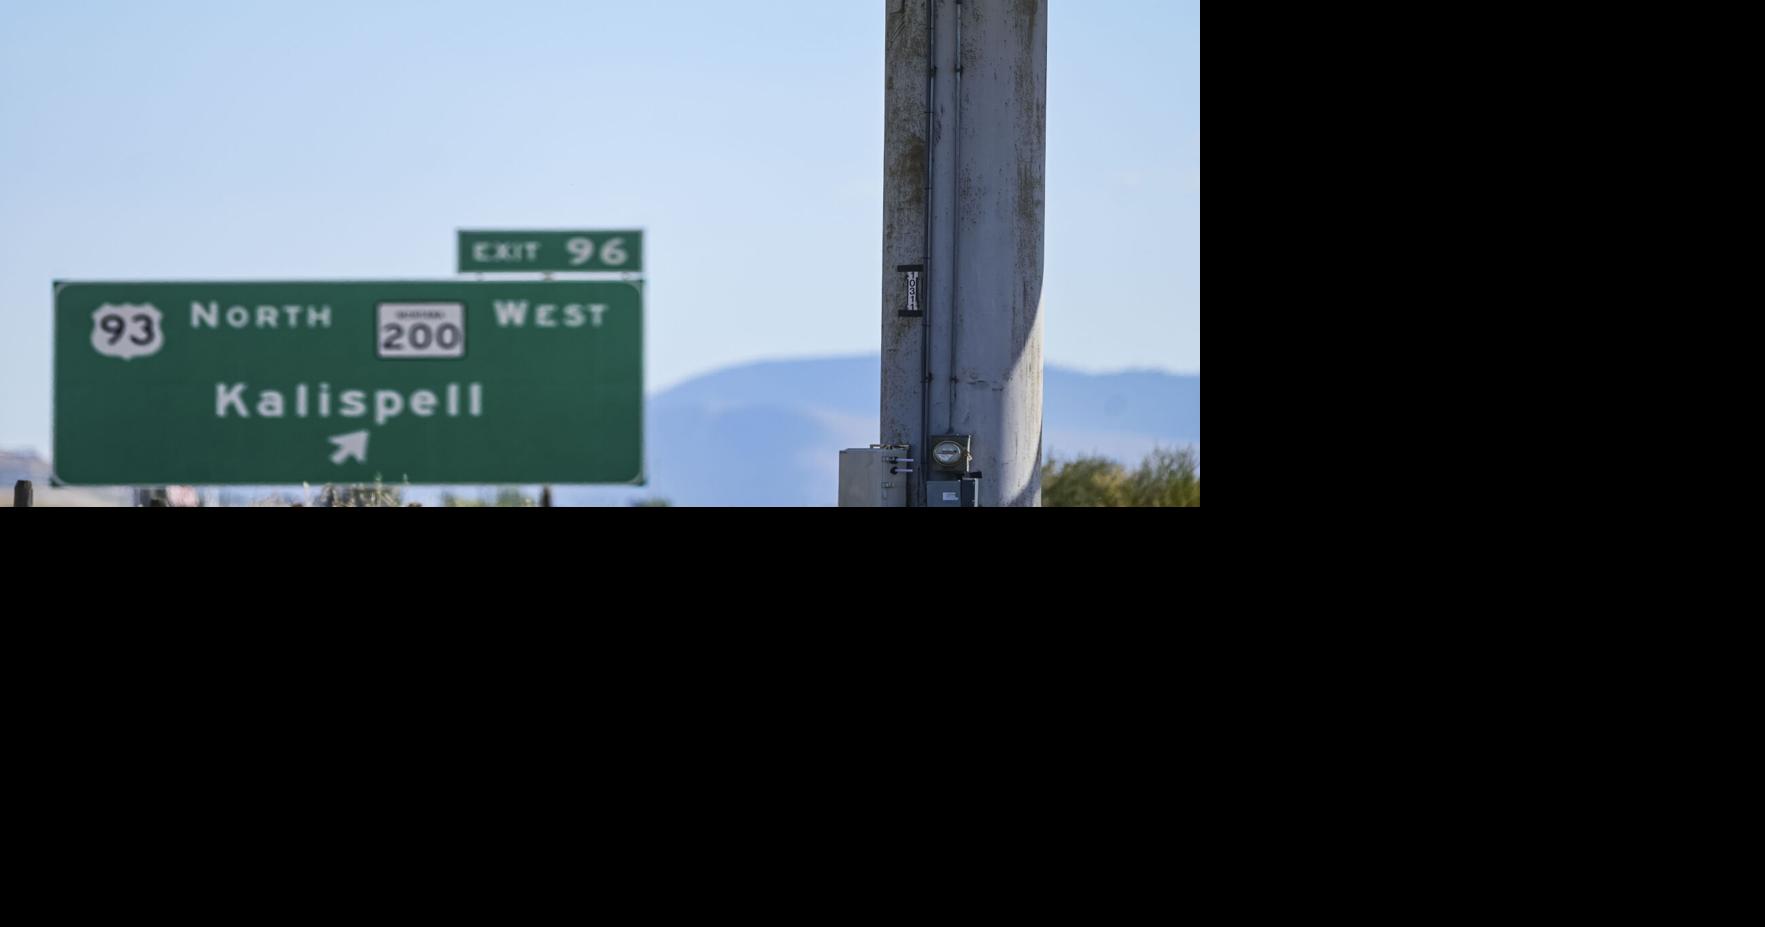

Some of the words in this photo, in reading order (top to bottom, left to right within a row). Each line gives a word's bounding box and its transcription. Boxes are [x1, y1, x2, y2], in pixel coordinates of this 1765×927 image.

[472, 241, 539, 262] EXIT
[566, 237, 628, 265] 96
[191, 301, 332, 328] NORTH
[494, 300, 608, 327] WEST
[101, 314, 155, 346] 93
[384, 322, 461, 351] 200
[215, 384, 482, 425] Kalispell
